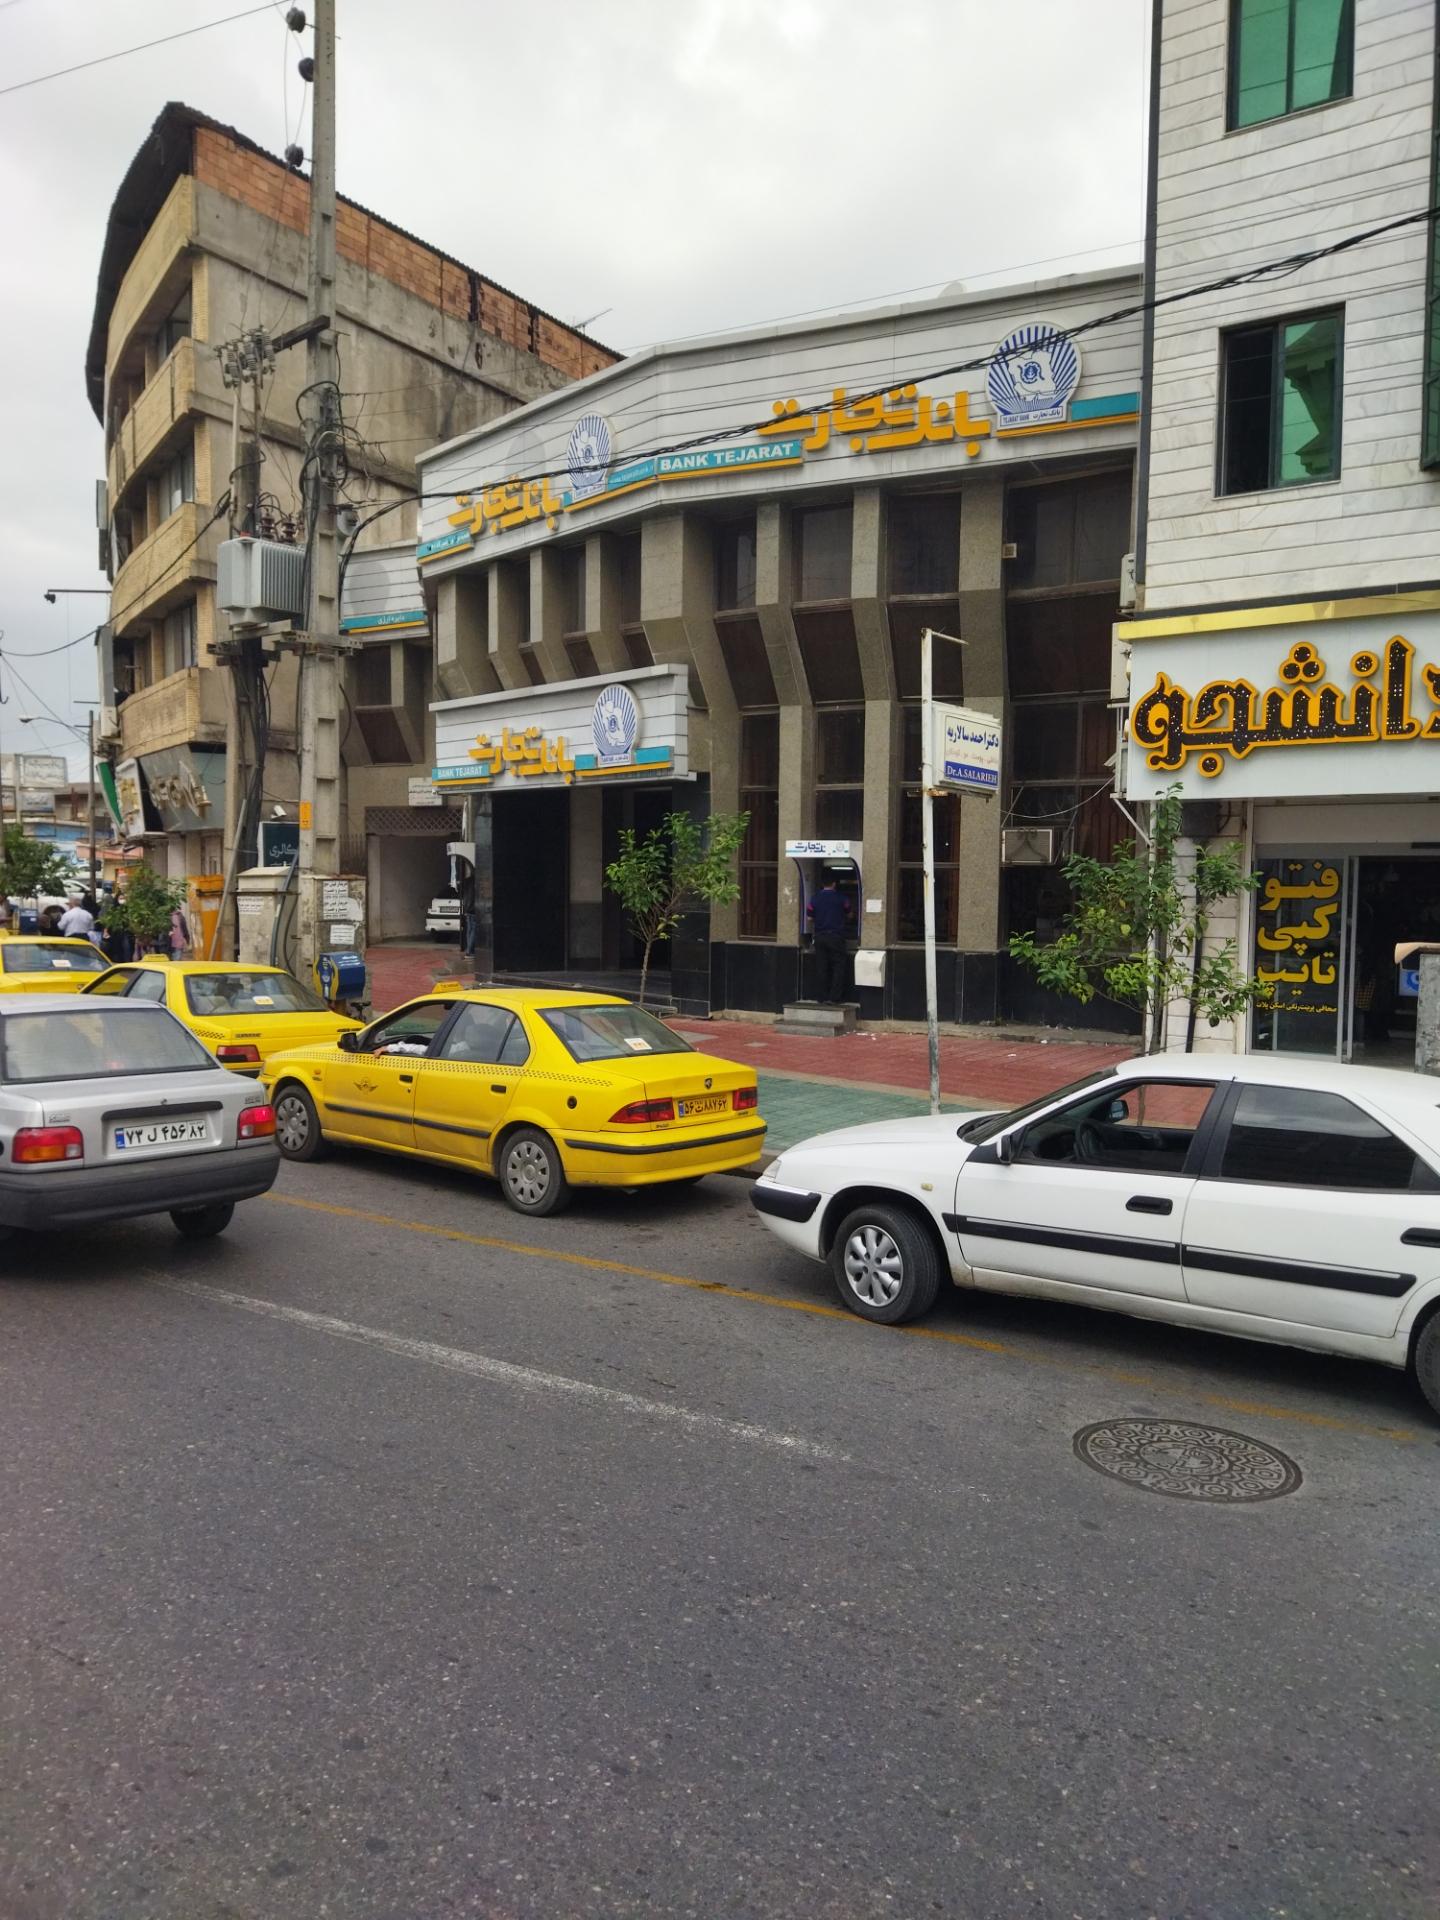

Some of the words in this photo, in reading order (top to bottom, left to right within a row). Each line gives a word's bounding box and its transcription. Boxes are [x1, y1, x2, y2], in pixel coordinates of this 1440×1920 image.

[757, 383, 917, 453] تجارت
[866, 391, 990, 457] بانک
[660, 455, 710, 471] BANK
[713, 443, 794, 465] TEJARAT
[448, 475, 520, 534] تجارت
[500, 478, 561, 531] بانک
[468, 726, 541, 776] تجارت
[947, 724, 970, 743] سالاریه
[970, 730, 987, 745] احمد
[984, 732, 999, 750] دکتر
[519, 736, 576, 784] بانک
[1259, 862, 1339, 911] فتو
[1258, 902, 1338, 956] کپی
[1257, 952, 1336, 998] تایپ
[126, 1129, 143, 1145] ۷۳
[147, 1128, 157, 1142] ل
[161, 1124, 186, 1140] ۴۵۶
[190, 1125, 204, 1138] ۸۲
